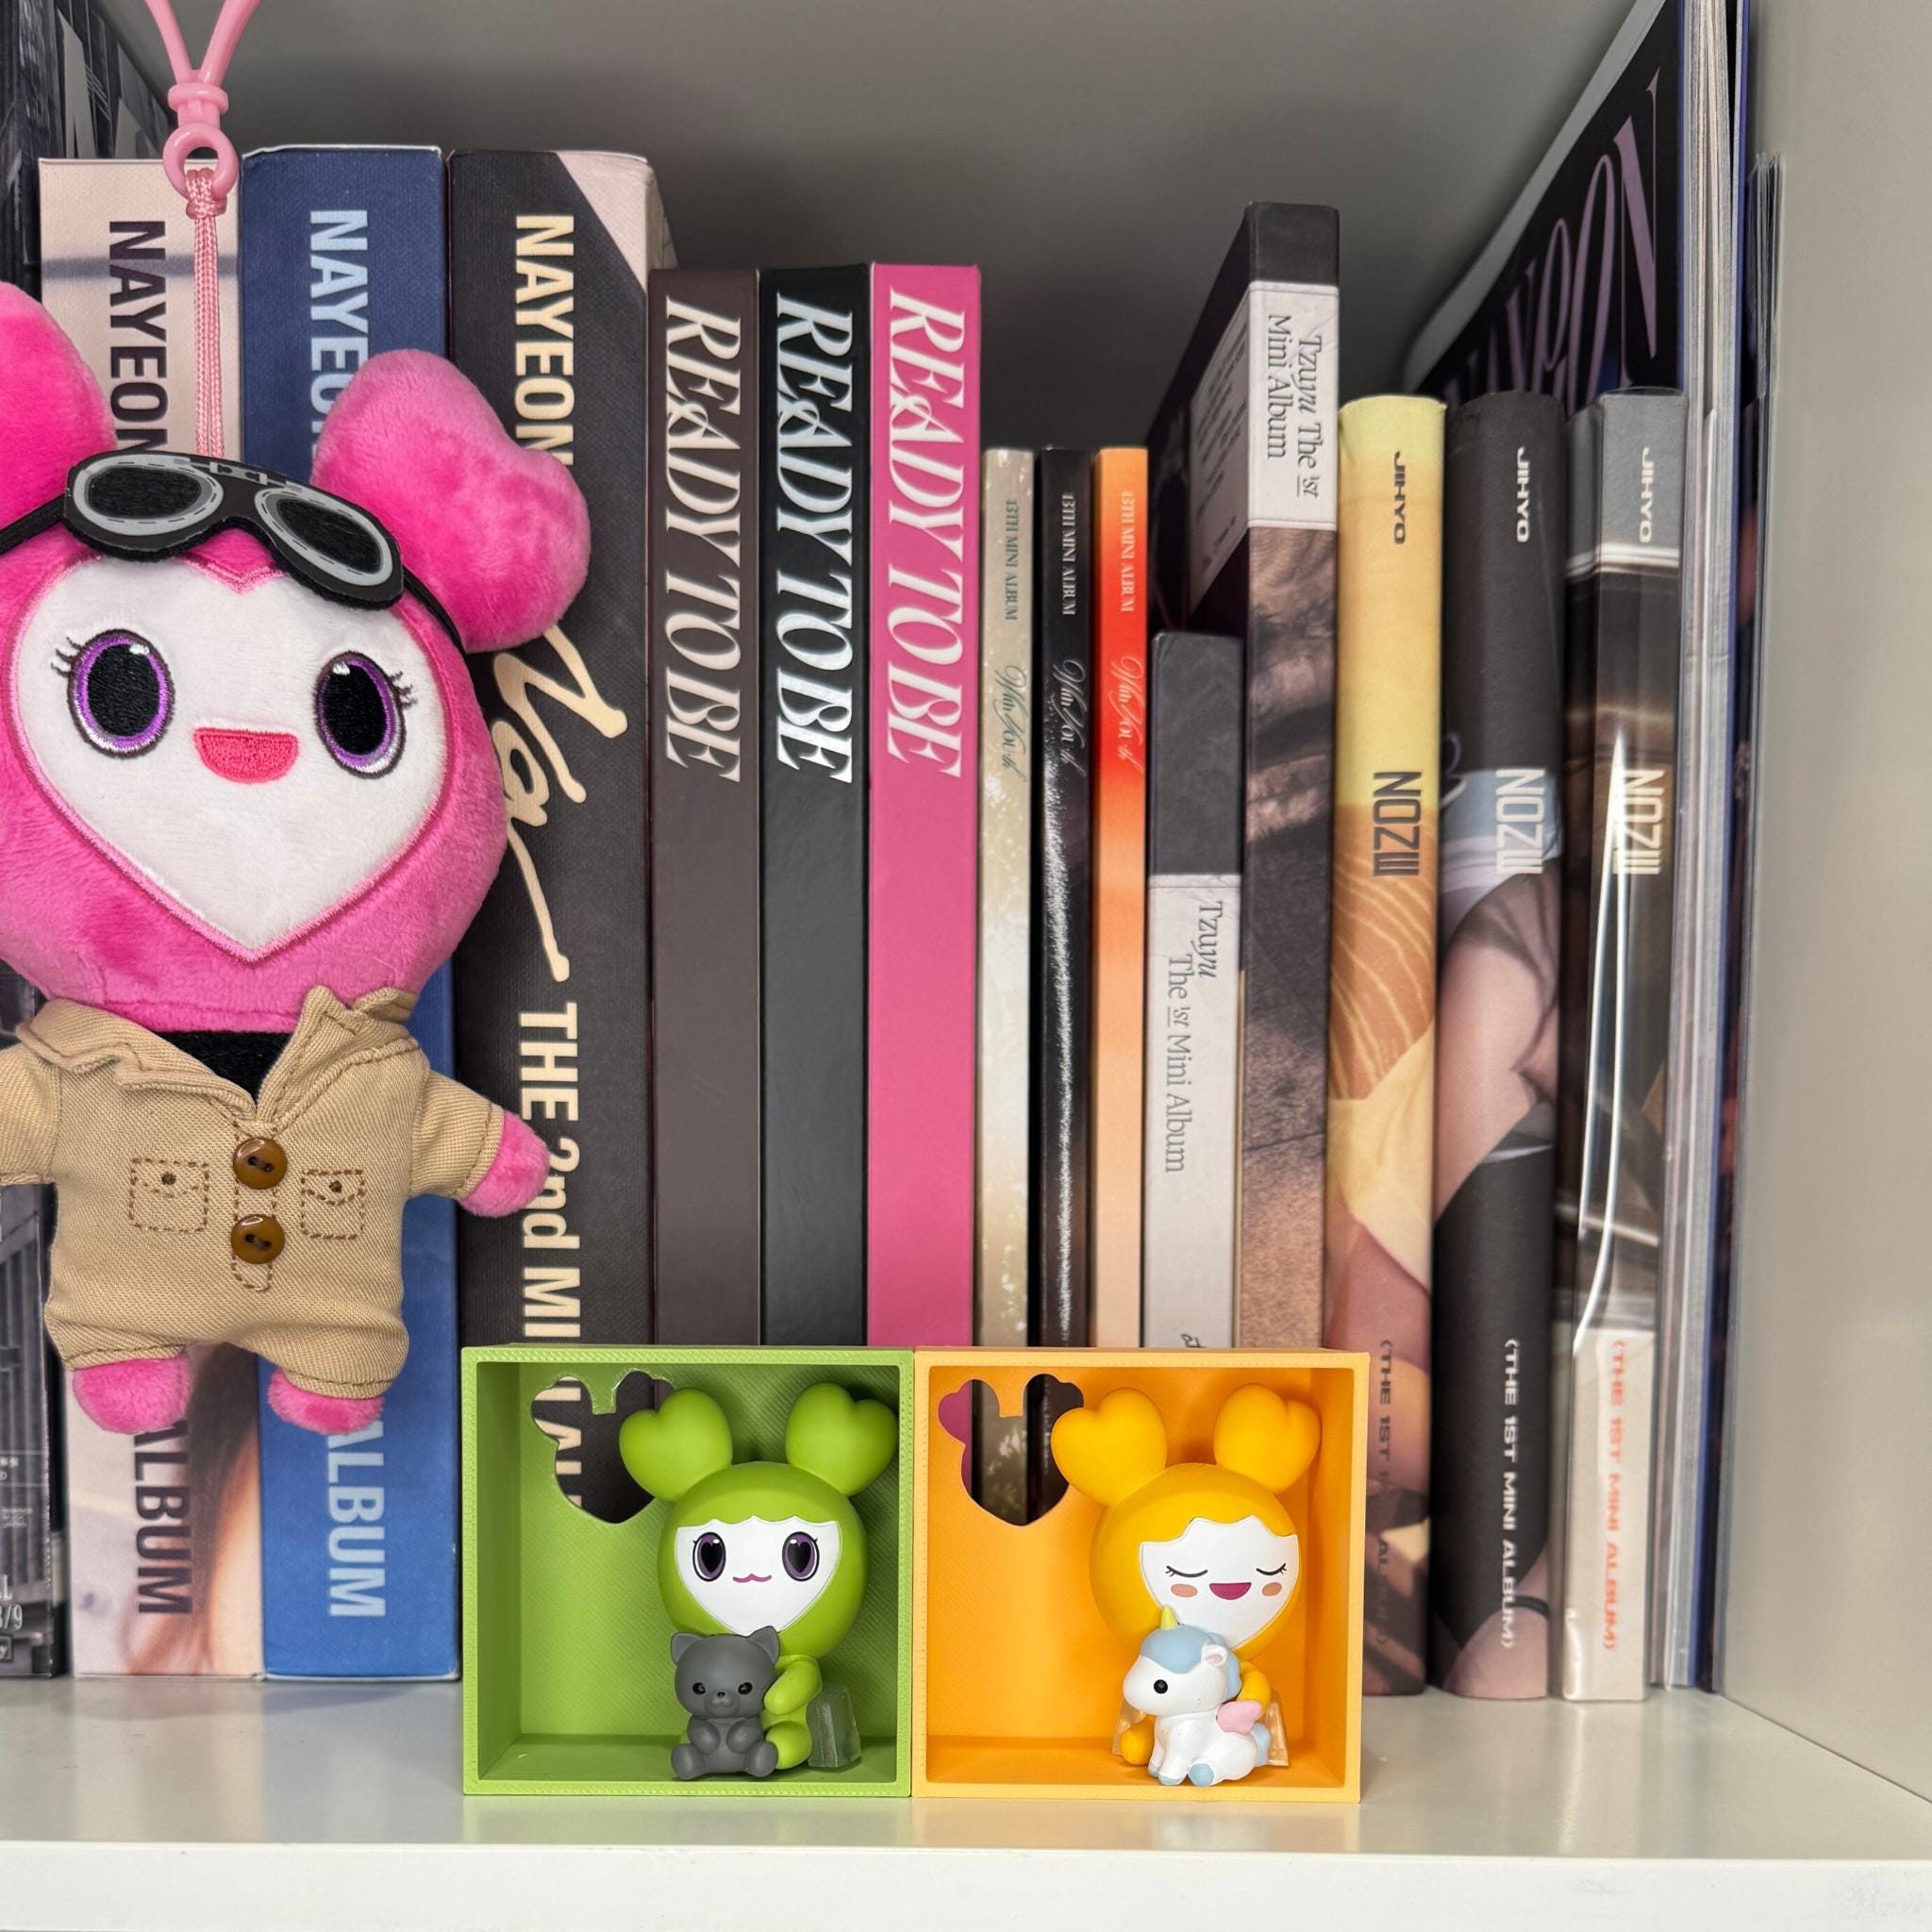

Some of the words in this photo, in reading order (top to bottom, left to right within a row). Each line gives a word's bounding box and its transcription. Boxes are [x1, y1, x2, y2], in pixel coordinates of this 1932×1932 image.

[1267, 314, 1292, 369] Mini
[1291, 335, 1323, 414] Tzuyu
[665, 294, 741, 568] READY
[775, 291, 853, 568] READY
[888, 286, 965, 564] READY
[1267, 375, 1293, 459] Album
[1297, 422, 1324, 469] The
[1005, 500, 1019, 535] 13TH
[1061, 491, 1076, 527] 13TH
[1120, 490, 1135, 525] 13TH
[1392, 451, 1407, 545] JIHYO
[1516, 446, 1530, 543] JIHYO
[1639, 446, 1655, 543] JIHYO
[1005, 537, 1019, 568] MINI
[1061, 529, 1076, 563] MINI
[1120, 525, 1135, 559] MINI
[664, 569, 741, 672] TO
[775, 569, 853, 672] TO
[887, 564, 965, 668] TO
[1004, 572, 1018, 622] ALBUM
[1061, 567, 1077, 615] ALBUM
[1120, 563, 1135, 613] ALBUM
[665, 666, 741, 784] BE
[776, 667, 853, 784] BE
[886, 661, 963, 778] BE
[1191, 900, 1224, 979] Tzuyu
[1167, 953, 1196, 1000] The
[518, 1001, 580, 1122] THE
[1166, 1033, 1192, 1090] Mini
[1165, 1091, 1194, 1174] Album
[1505, 1339, 1519, 1406] (THE
[1610, 1340, 1625, 1407] (THE
[1378, 1415, 1391, 1460] 1ST
[1504, 1415, 1518, 1462] 1ST
[1609, 1417, 1624, 1463] 1ST
[1503, 1472, 1517, 1530] MINI
[1607, 1474, 1622, 1531] MINI
[1502, 1539, 1516, 1648] ALBUM)
[1604, 1541, 1618, 1650] ALBUM)
